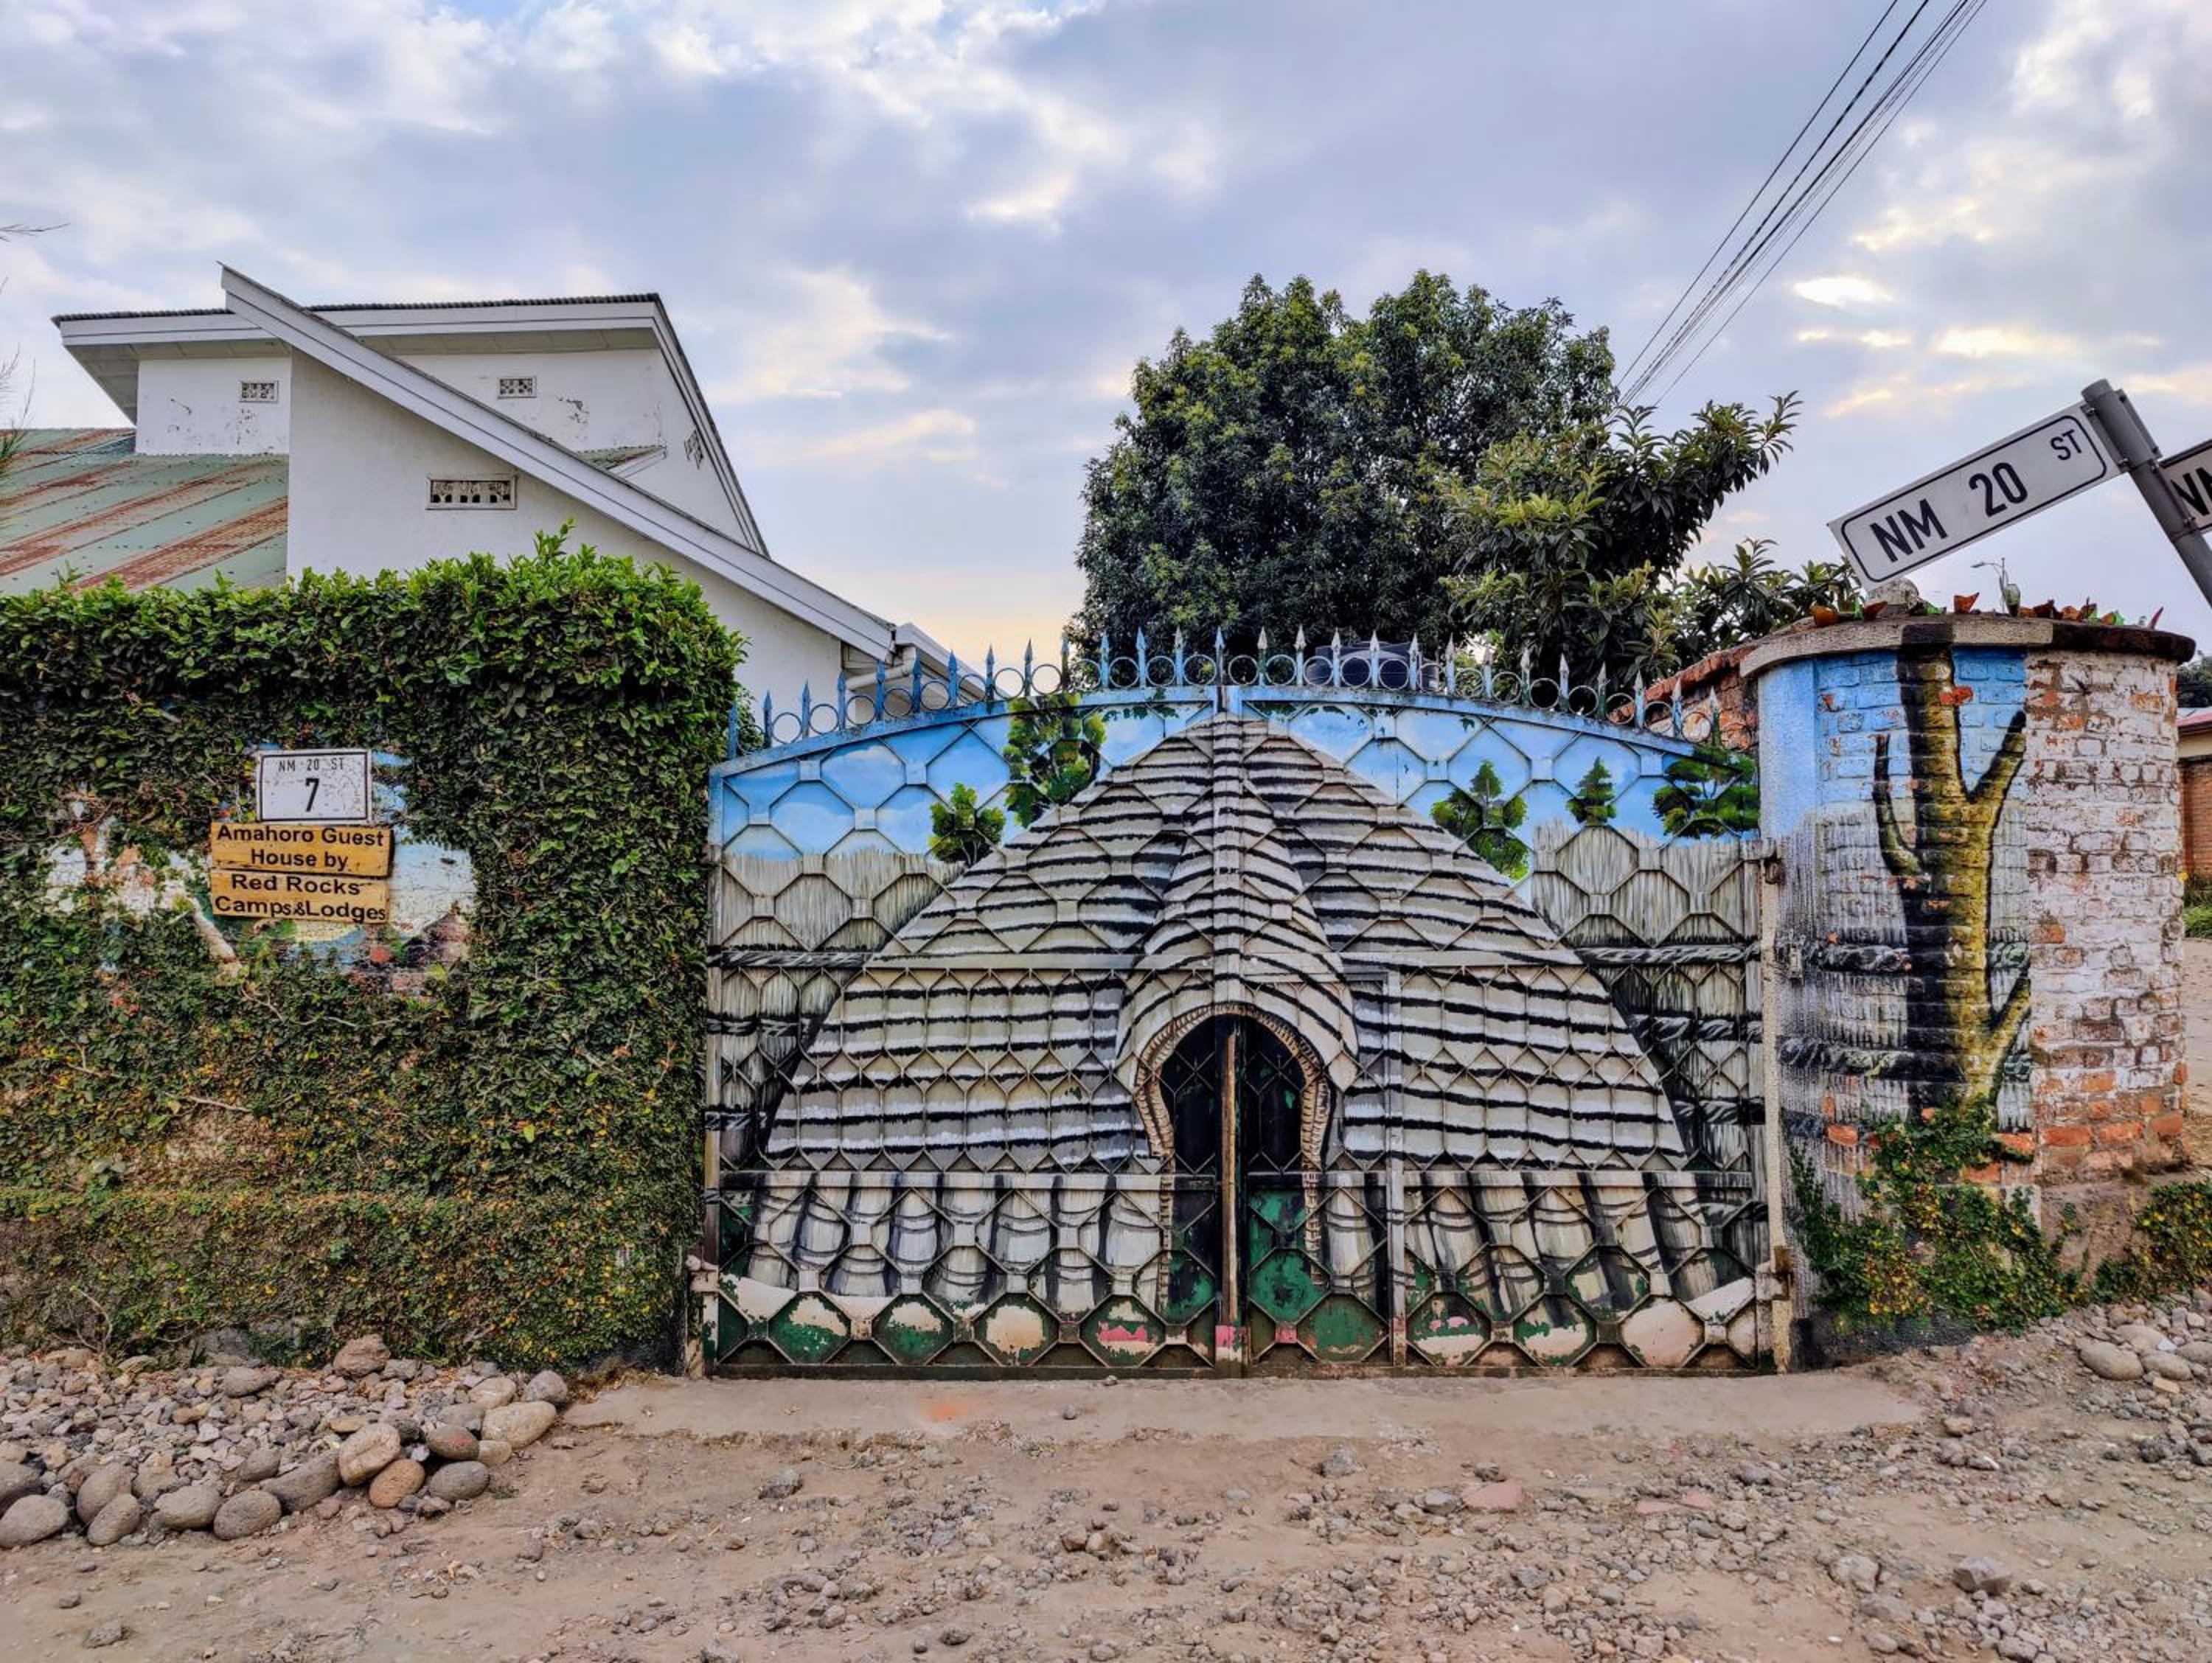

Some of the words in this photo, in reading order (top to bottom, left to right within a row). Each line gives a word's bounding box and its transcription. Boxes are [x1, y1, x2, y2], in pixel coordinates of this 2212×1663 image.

[1870, 498, 1947, 562] NM
[1969, 462, 2028, 517] 20
[2051, 430, 2083, 461] ST
[279, 760, 295, 772] NM
[307, 759, 319, 771] 20
[331, 758, 344, 770] ST
[305, 778, 319, 812] 7
[217, 825, 314, 843] Amahoro
[321, 827, 384, 846] Guest
[251, 848, 317, 866] House
[324, 851, 349, 871] by
[232, 874, 277, 890] Red
[286, 876, 361, 895] Rocks
